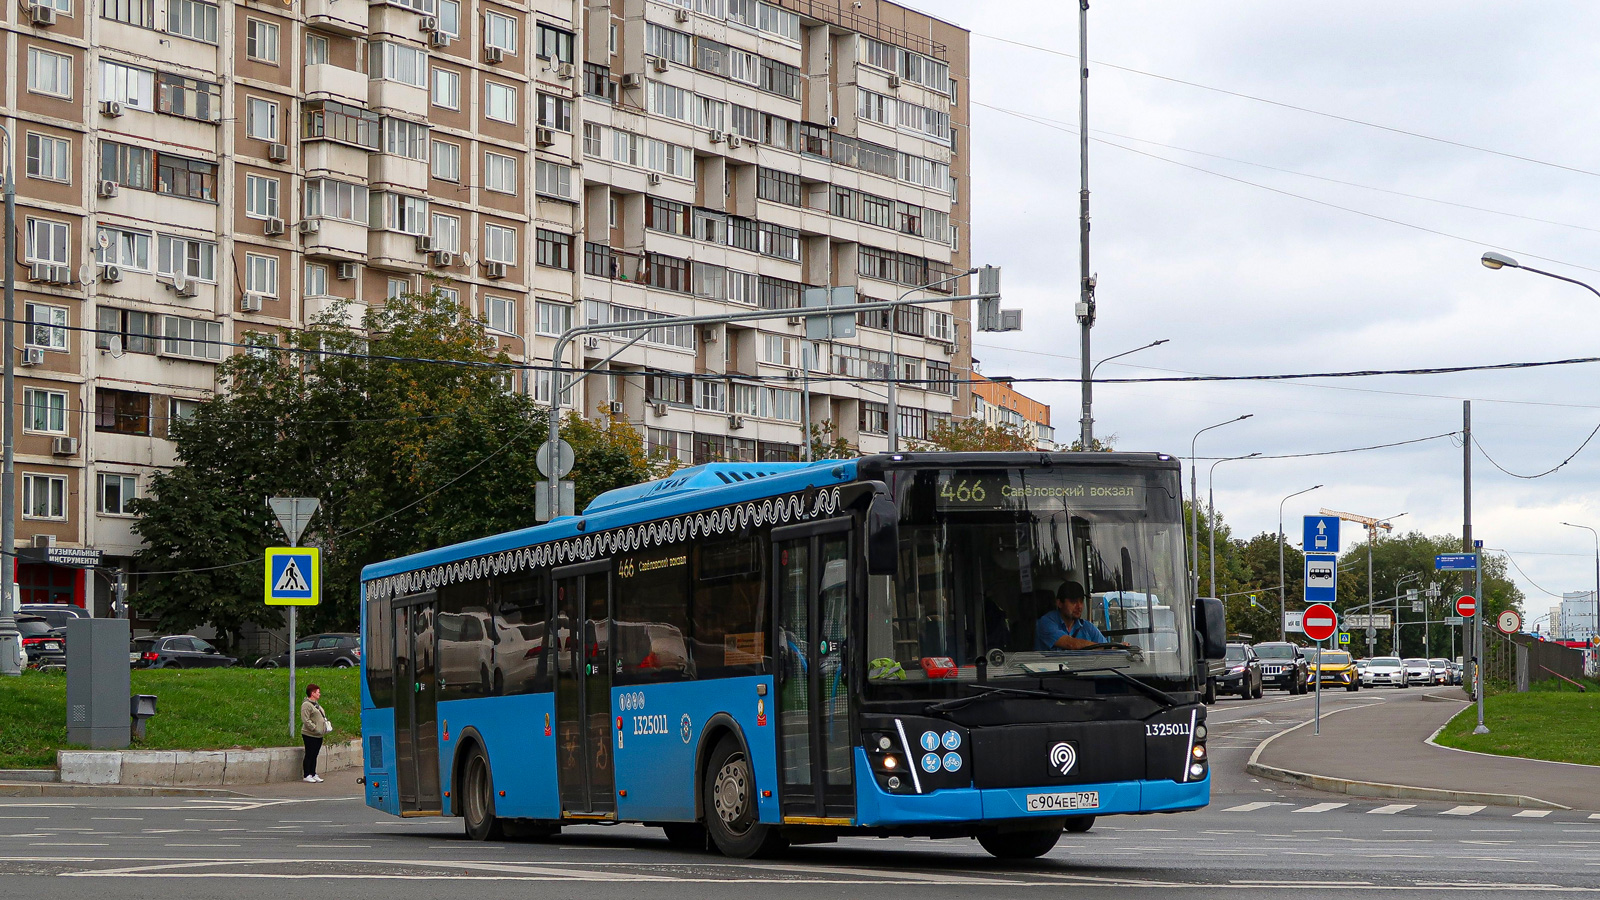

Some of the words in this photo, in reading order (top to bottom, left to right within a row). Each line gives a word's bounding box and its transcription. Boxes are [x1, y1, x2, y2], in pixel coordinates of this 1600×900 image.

[940, 479, 986, 502] 466
[1001, 484, 1085, 497] Савёловский
[1090, 486, 1134, 497] вокзал
[48, 548, 100, 557] МУЗЫКАЛЬНЫЕ
[48, 556, 99, 565] ИНСТРУМЕНТЫ
[618, 558, 635, 578] 466
[1507, 618, 1512, 626] 5
[633, 714, 669, 735] 1325011
[1145, 722, 1190, 736] 1325011
[1078, 793, 1095, 804] 797
